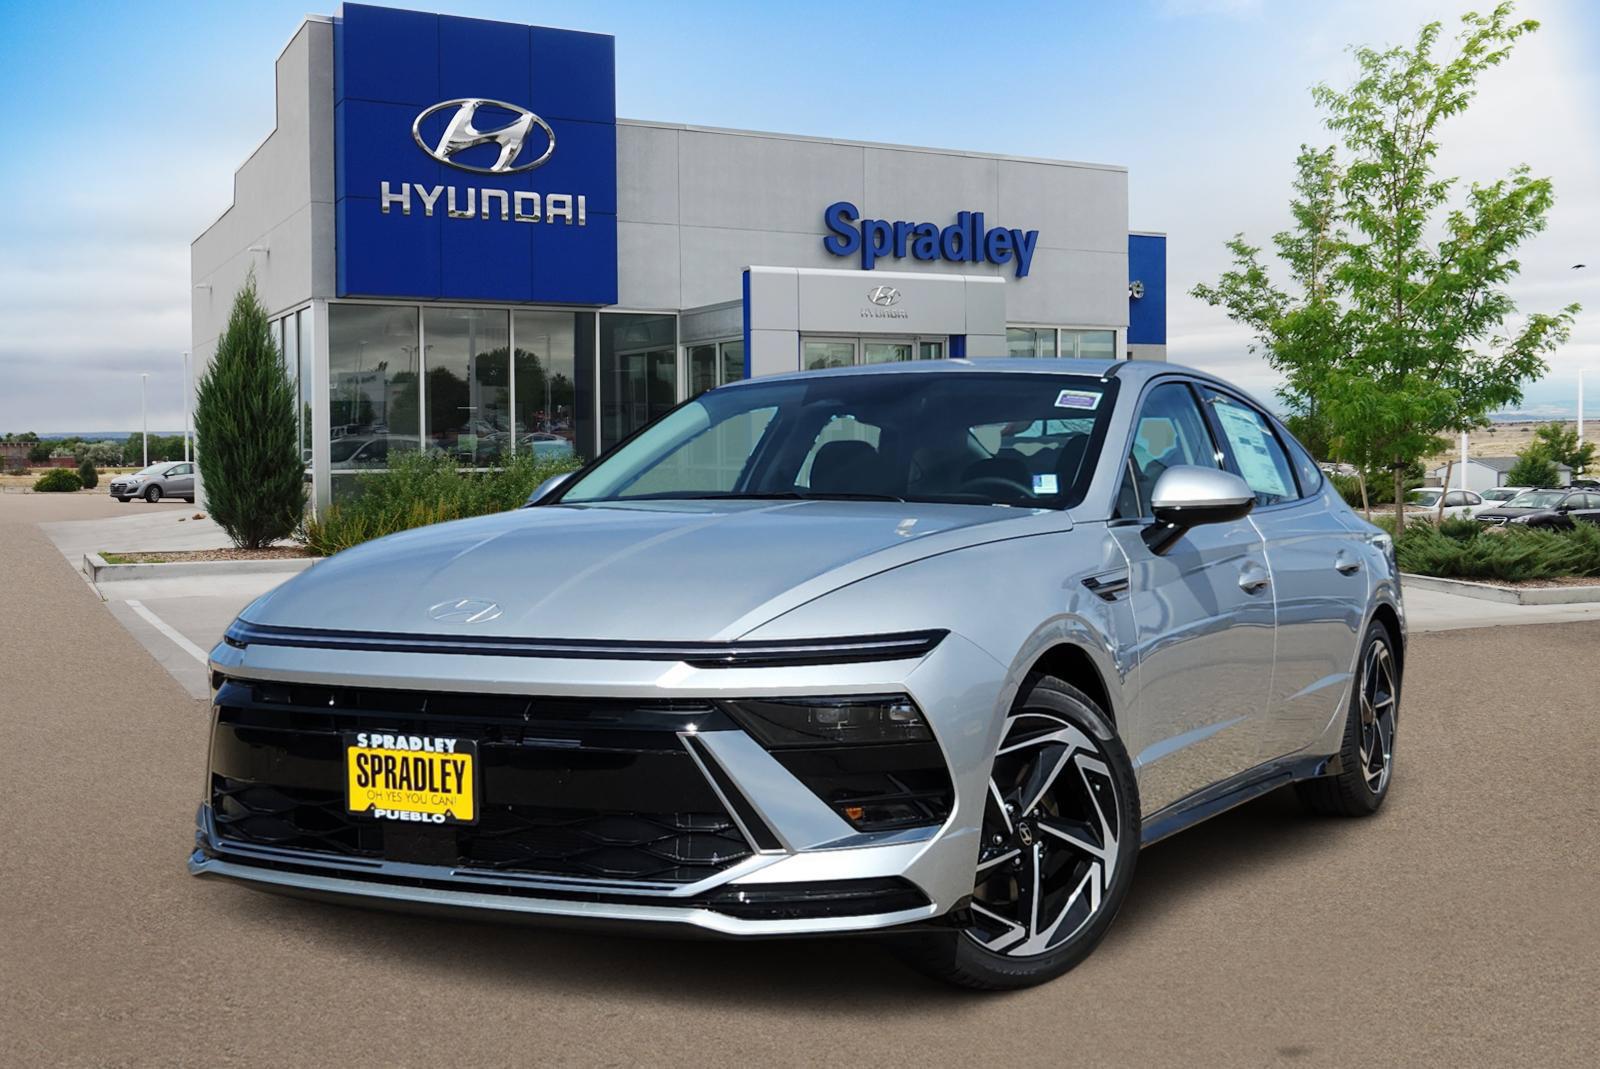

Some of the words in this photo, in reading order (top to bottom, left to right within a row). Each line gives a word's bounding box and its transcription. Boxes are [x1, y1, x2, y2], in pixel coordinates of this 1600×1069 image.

[380, 181, 586, 226] HYUNDAI
[823, 201, 1039, 278] Spradley
[356, 752, 465, 794] SPRADLEY
[366, 790, 382, 801] OH
[386, 791, 402, 803] YES
[405, 793, 428, 805] YOU
[374, 809, 446, 824] PUEBLO
